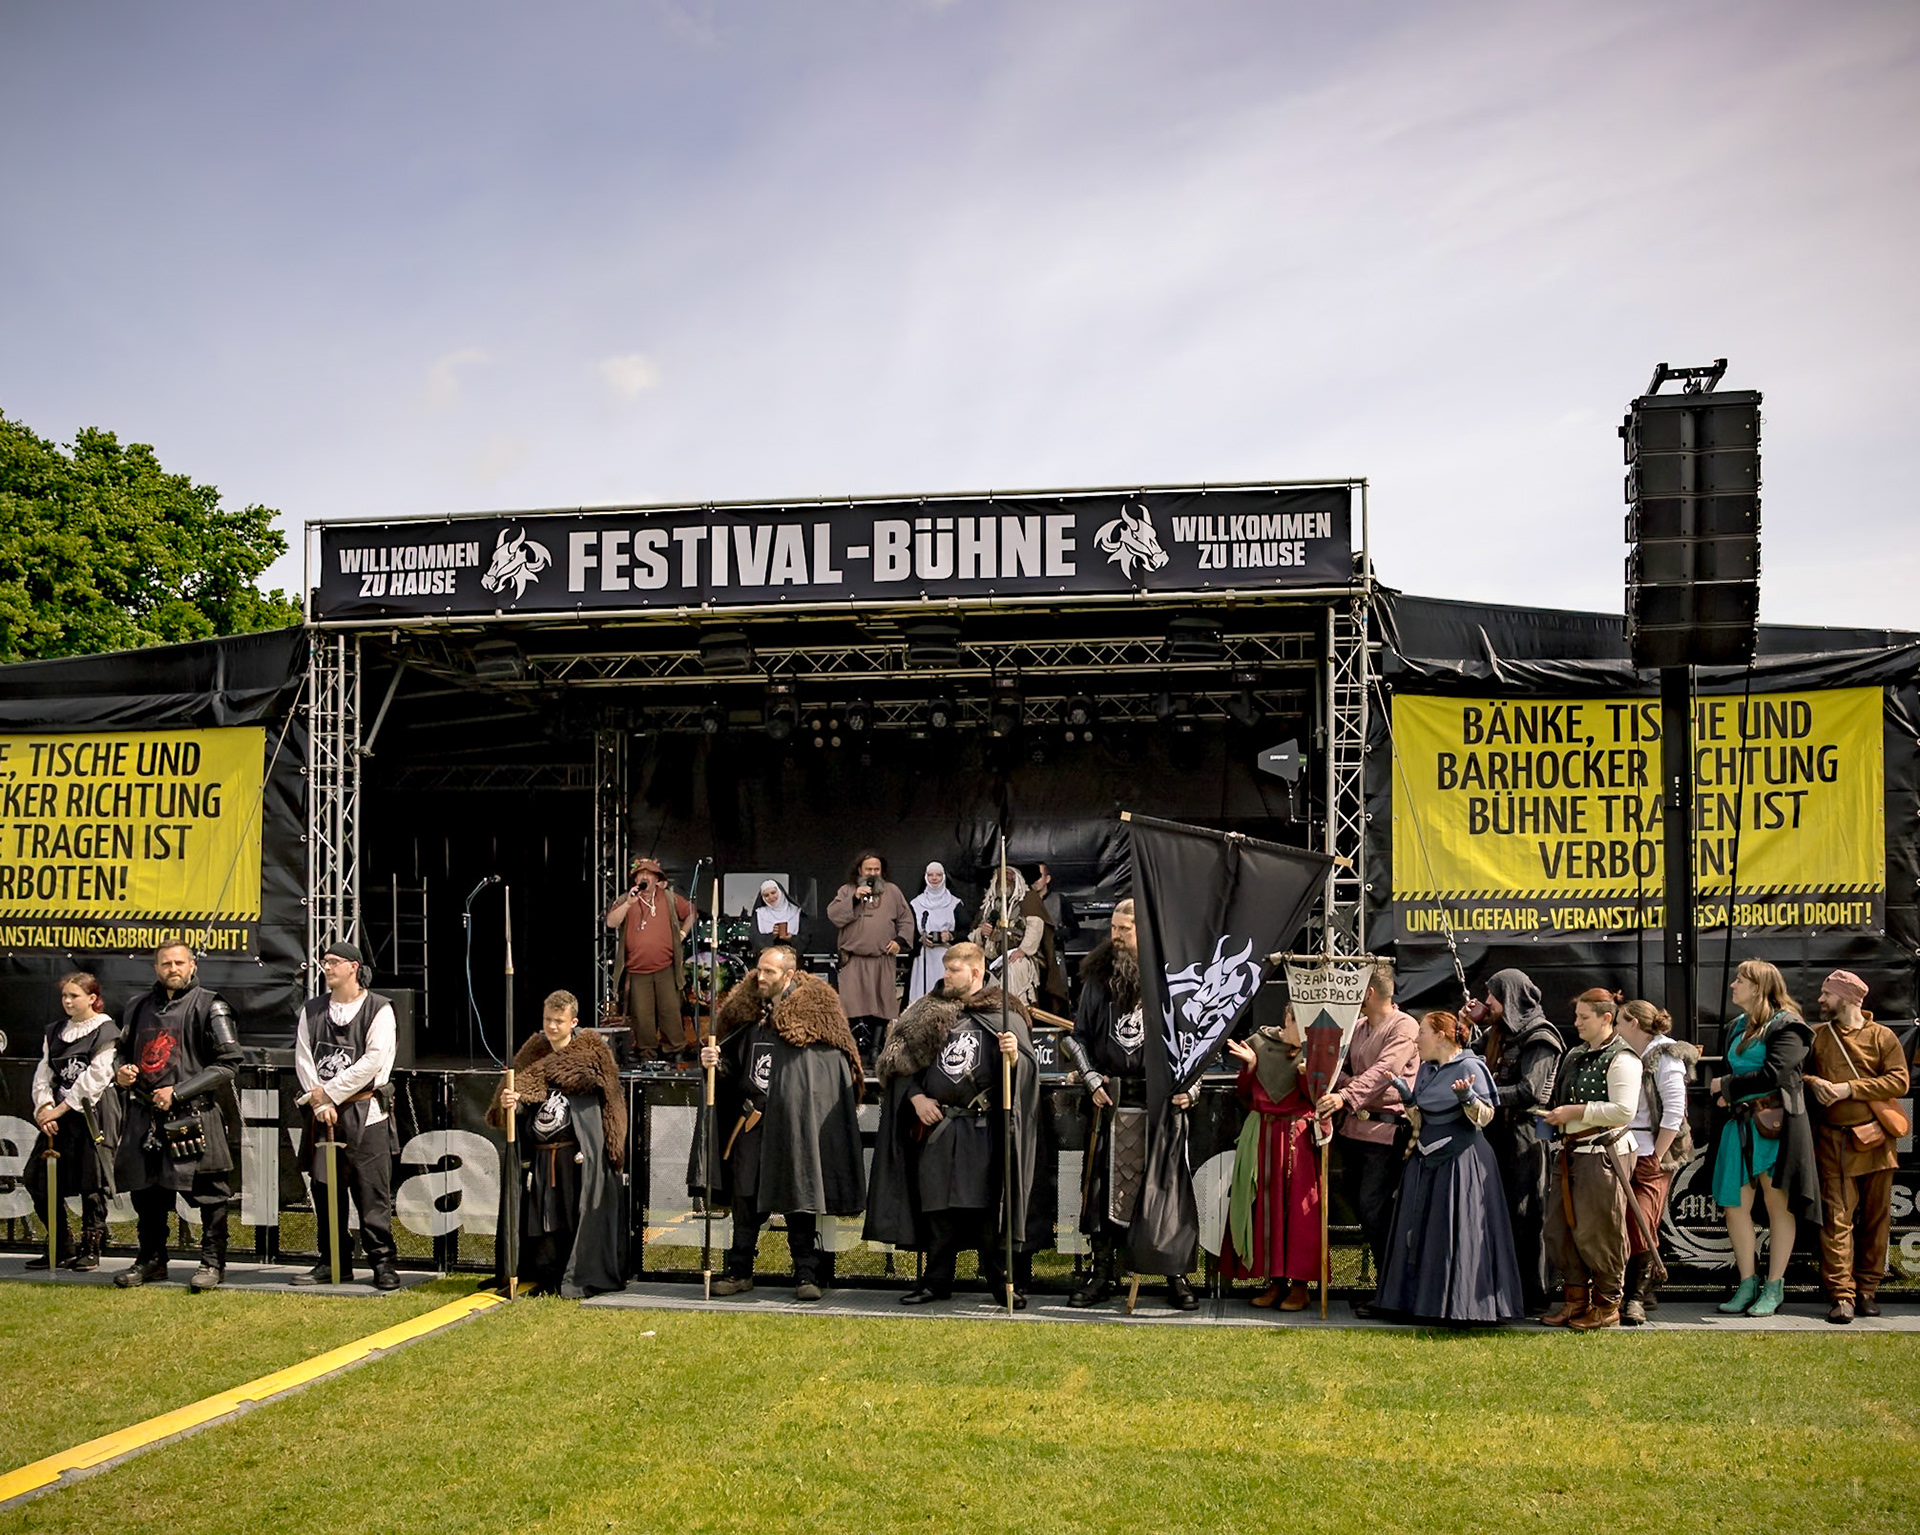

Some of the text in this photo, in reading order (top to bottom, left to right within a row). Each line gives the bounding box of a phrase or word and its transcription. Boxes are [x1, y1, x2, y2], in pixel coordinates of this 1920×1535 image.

[1172, 512, 1332, 543] WILLKOMMEN
[339, 541, 480, 574] WILLKOMMEN
[567, 513, 1077, 593] FESTIVAL-BÜHNE
[1197, 540, 1306, 570] ZU HAUSE
[359, 569, 457, 598] ZU HAUSE
[1462, 700, 1813, 747] BÄNKE, TISHE UND
[29, 742, 130, 777] TISCHE
[136, 742, 201, 776] UND
[1437, 750, 1649, 791] BARHOCKER
[0, 783, 222, 818] KER RICHTUNG
[1469, 789, 1809, 836] BÜHNE TRAEN IST
[13, 824, 133, 859] TRAGEN
[144, 824, 193, 859] IST
[1539, 837, 1737, 880] VERBON!
[1804, 902, 1873, 926] DROHT!
[184, 928, 249, 951] DROHT!
[1294, 972, 1360, 987] SZANDORS
